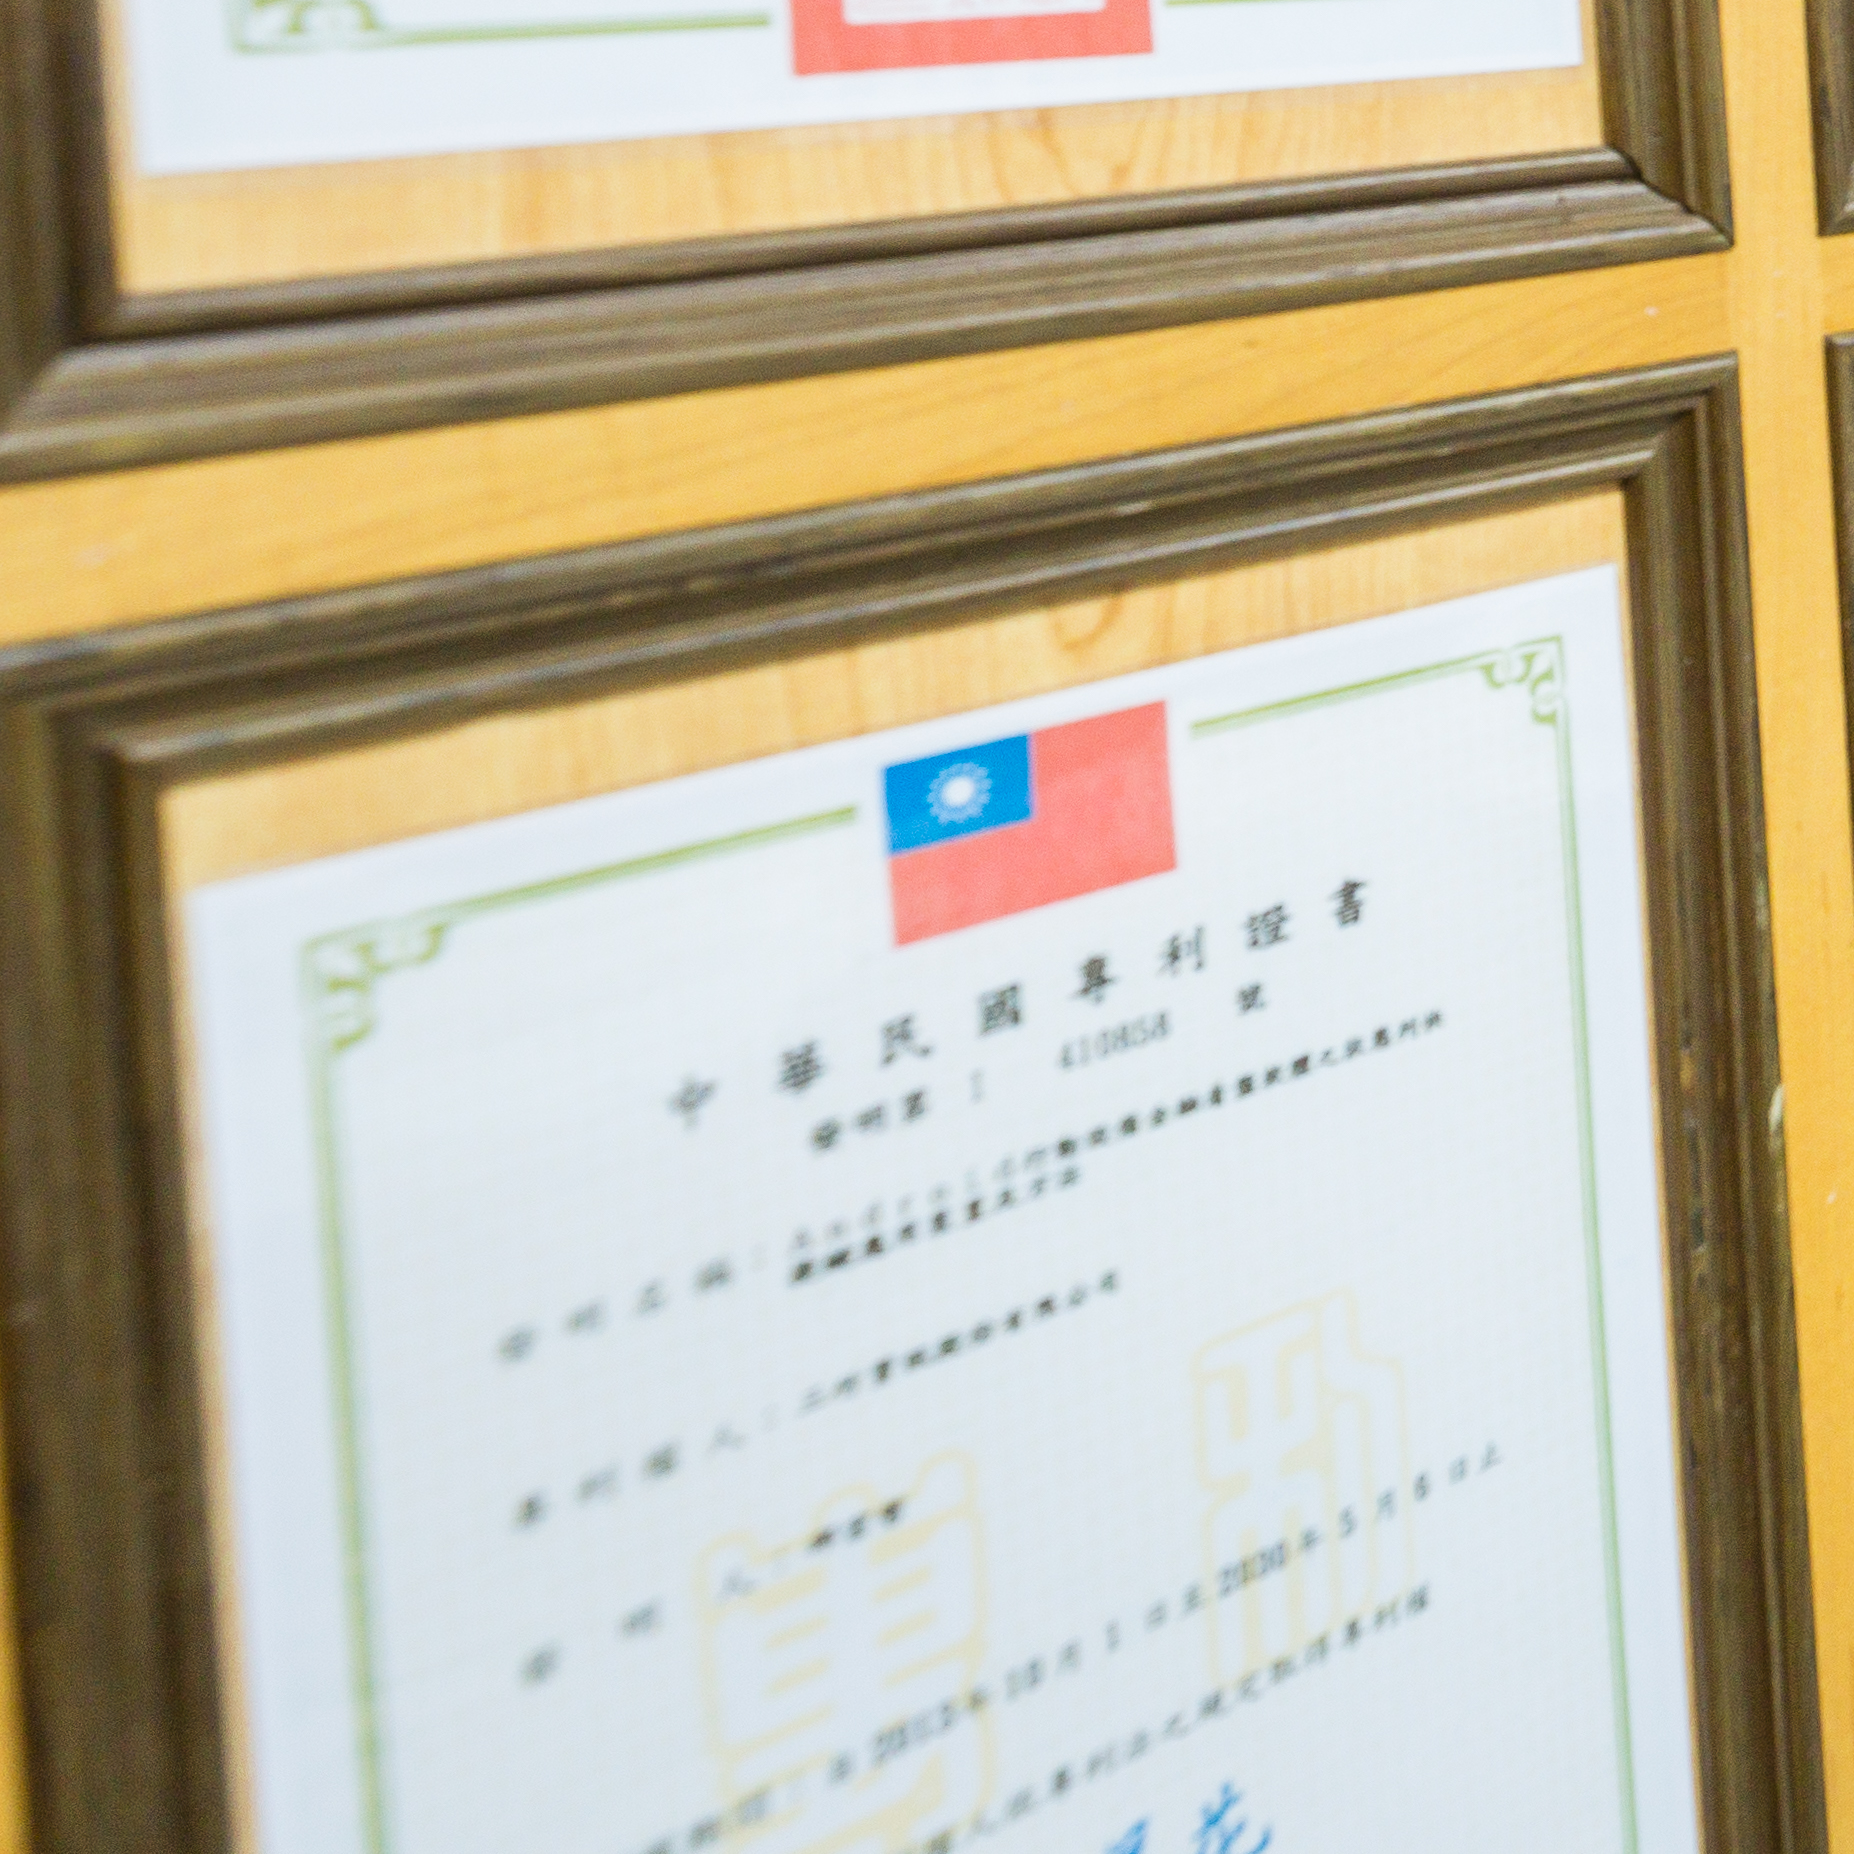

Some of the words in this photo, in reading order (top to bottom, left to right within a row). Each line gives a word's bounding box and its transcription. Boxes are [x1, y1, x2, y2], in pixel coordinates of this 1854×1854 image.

[667, 877, 1367, 1126] 中華民國專利證書
[1235, 981, 1266, 1015] 號
